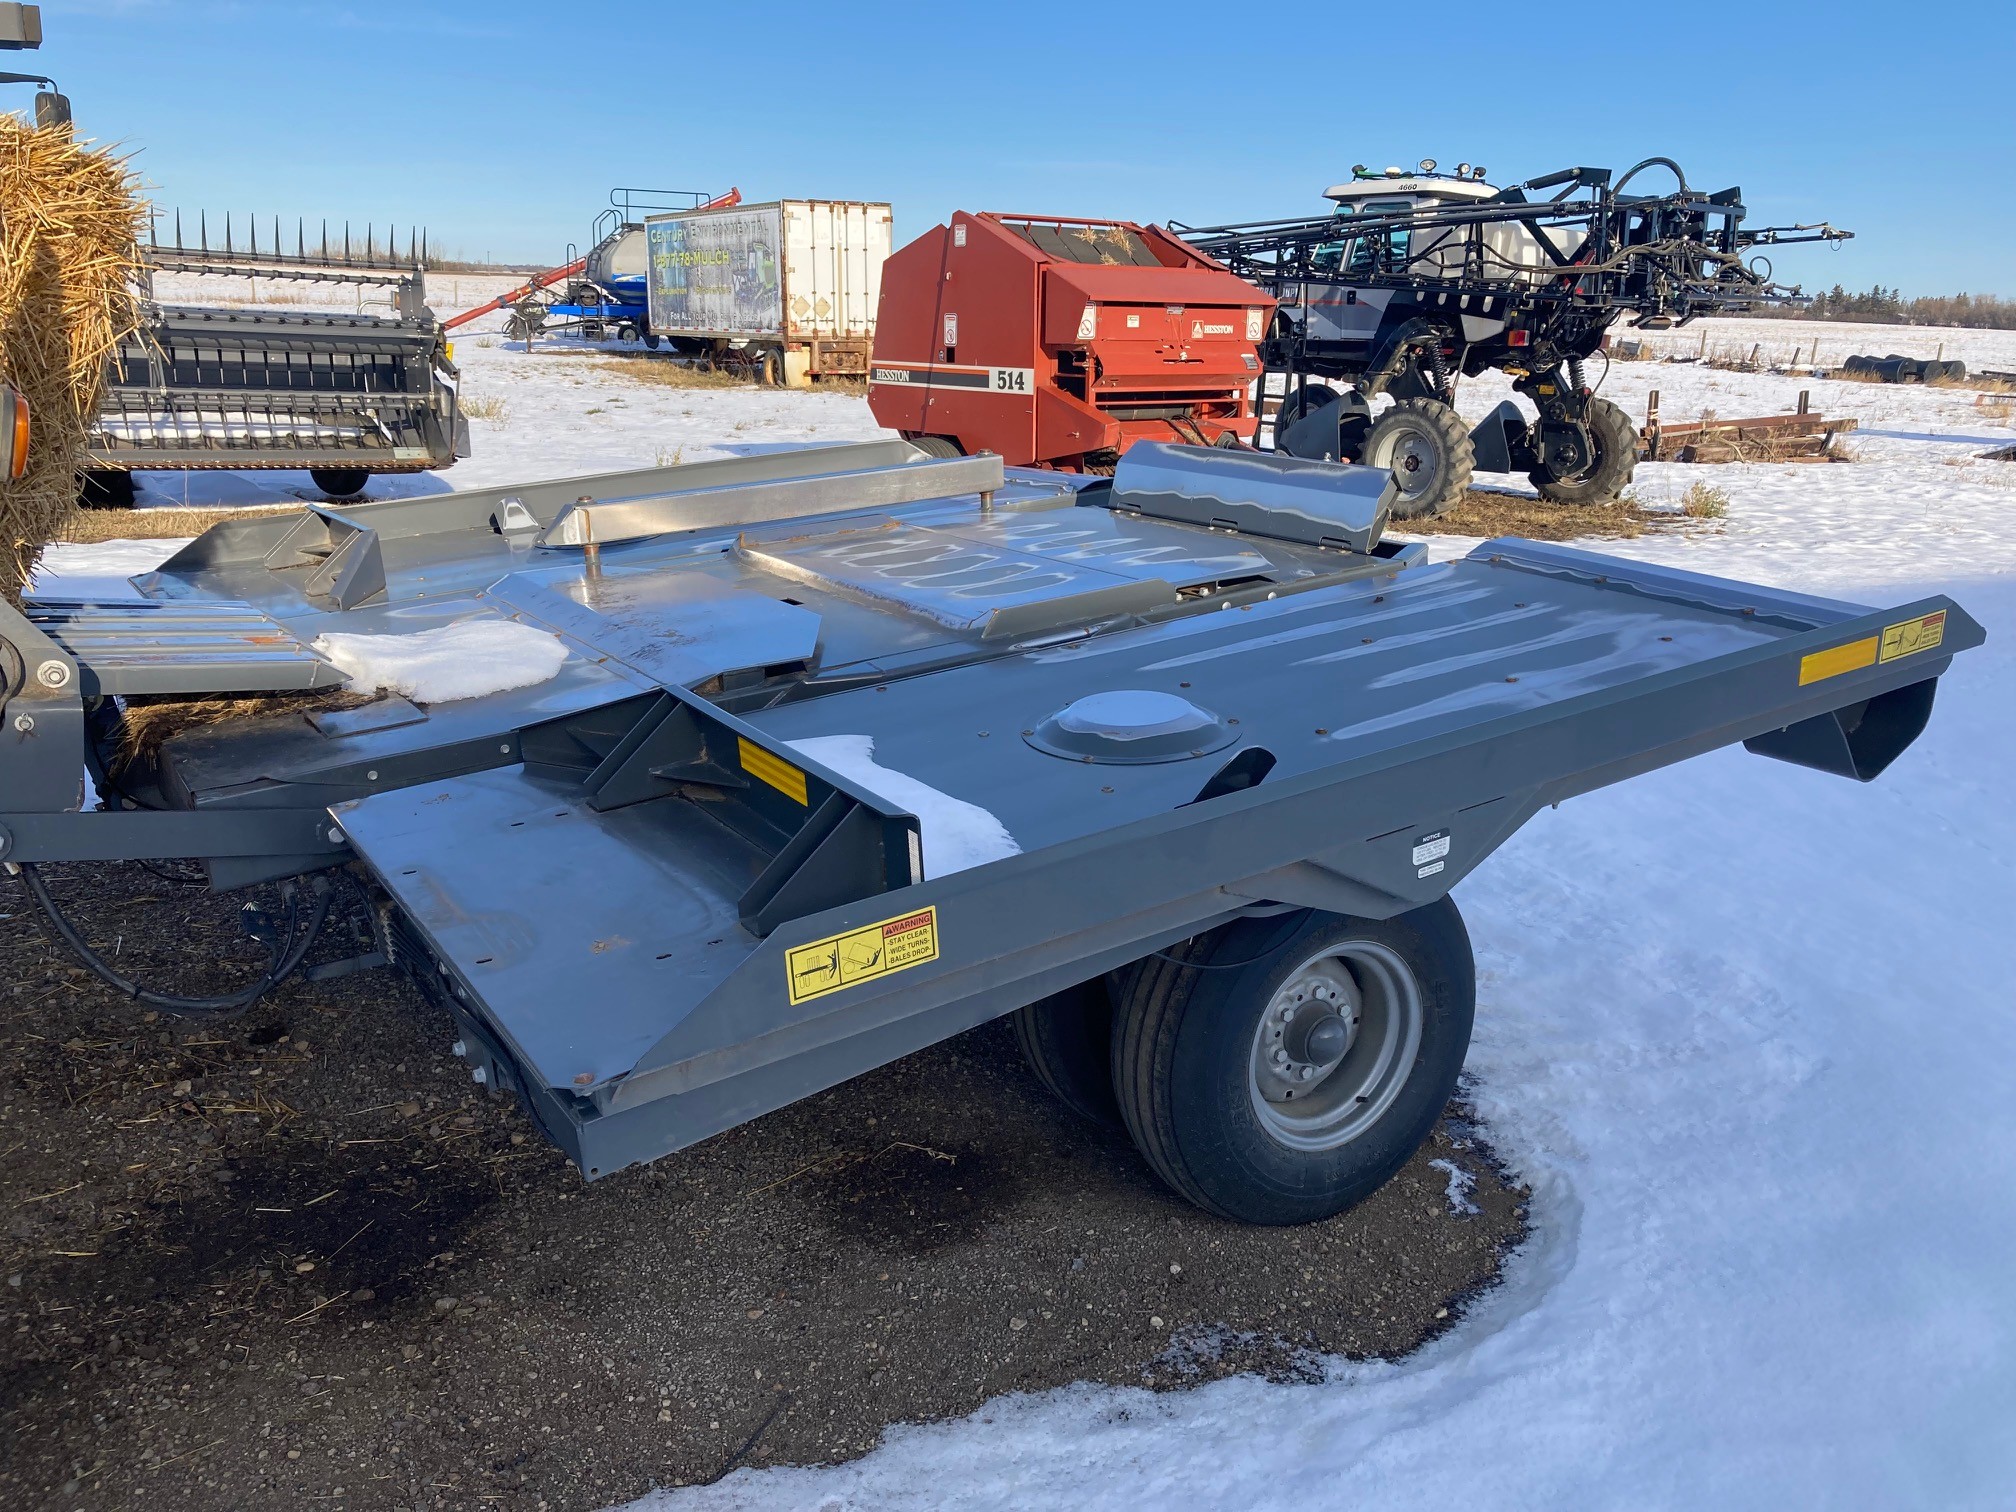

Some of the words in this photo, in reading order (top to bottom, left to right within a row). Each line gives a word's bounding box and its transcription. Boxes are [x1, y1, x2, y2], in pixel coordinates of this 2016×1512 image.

[1398, 183, 1418, 191] 4660
[650, 229, 688, 244] CENTURY
[1203, 325, 1234, 334] HESSTON
[876, 369, 910, 382] HESSTON
[997, 371, 1025, 391] 514
[1422, 832, 1441, 843] NOTICE
[892, 915, 930, 932] WARNING
